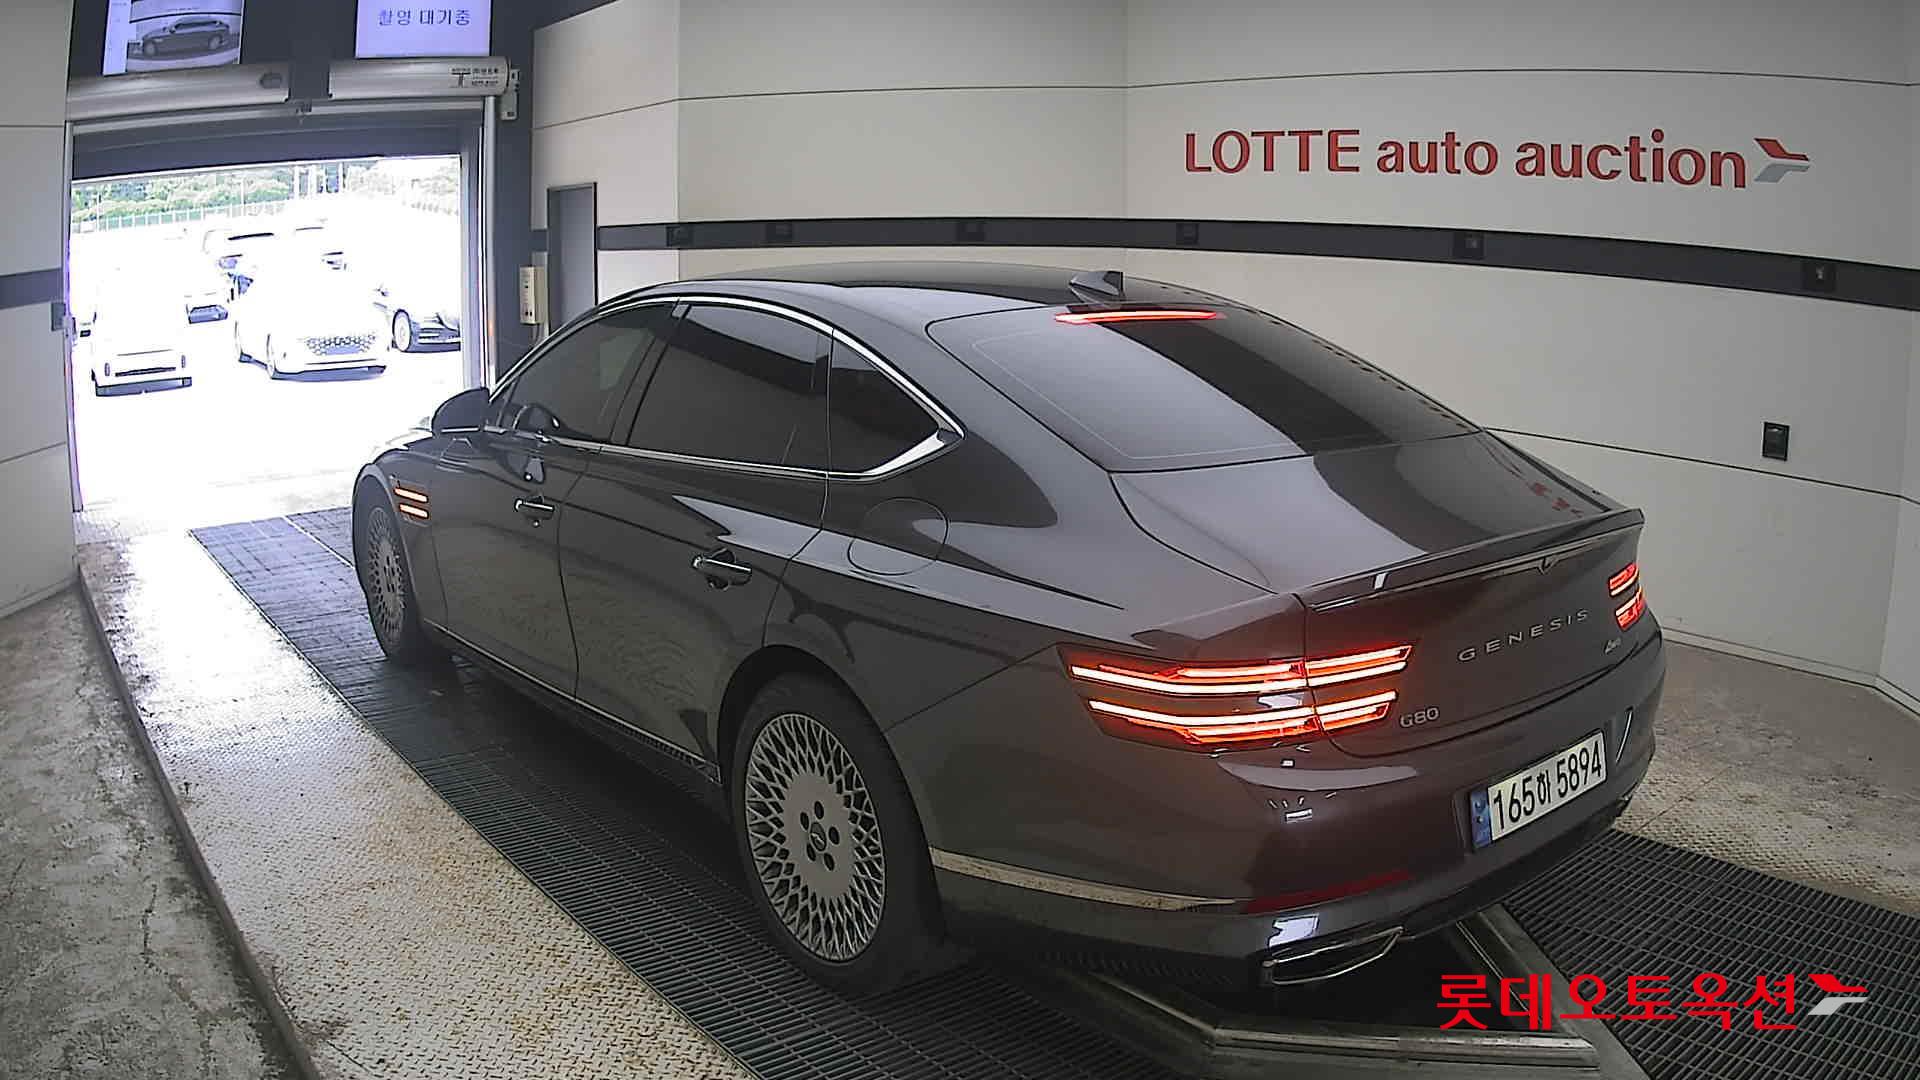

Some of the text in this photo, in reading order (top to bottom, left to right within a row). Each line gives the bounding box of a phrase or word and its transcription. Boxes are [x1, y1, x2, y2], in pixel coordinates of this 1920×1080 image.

[420, 9, 471, 26] 대기중
[1185, 129, 1746, 188] LOTTE auto auction
[1458, 608, 1589, 662] GENESIS
[1400, 706, 1440, 728] G80
[1493, 741, 1602, 830] 165하 5894
